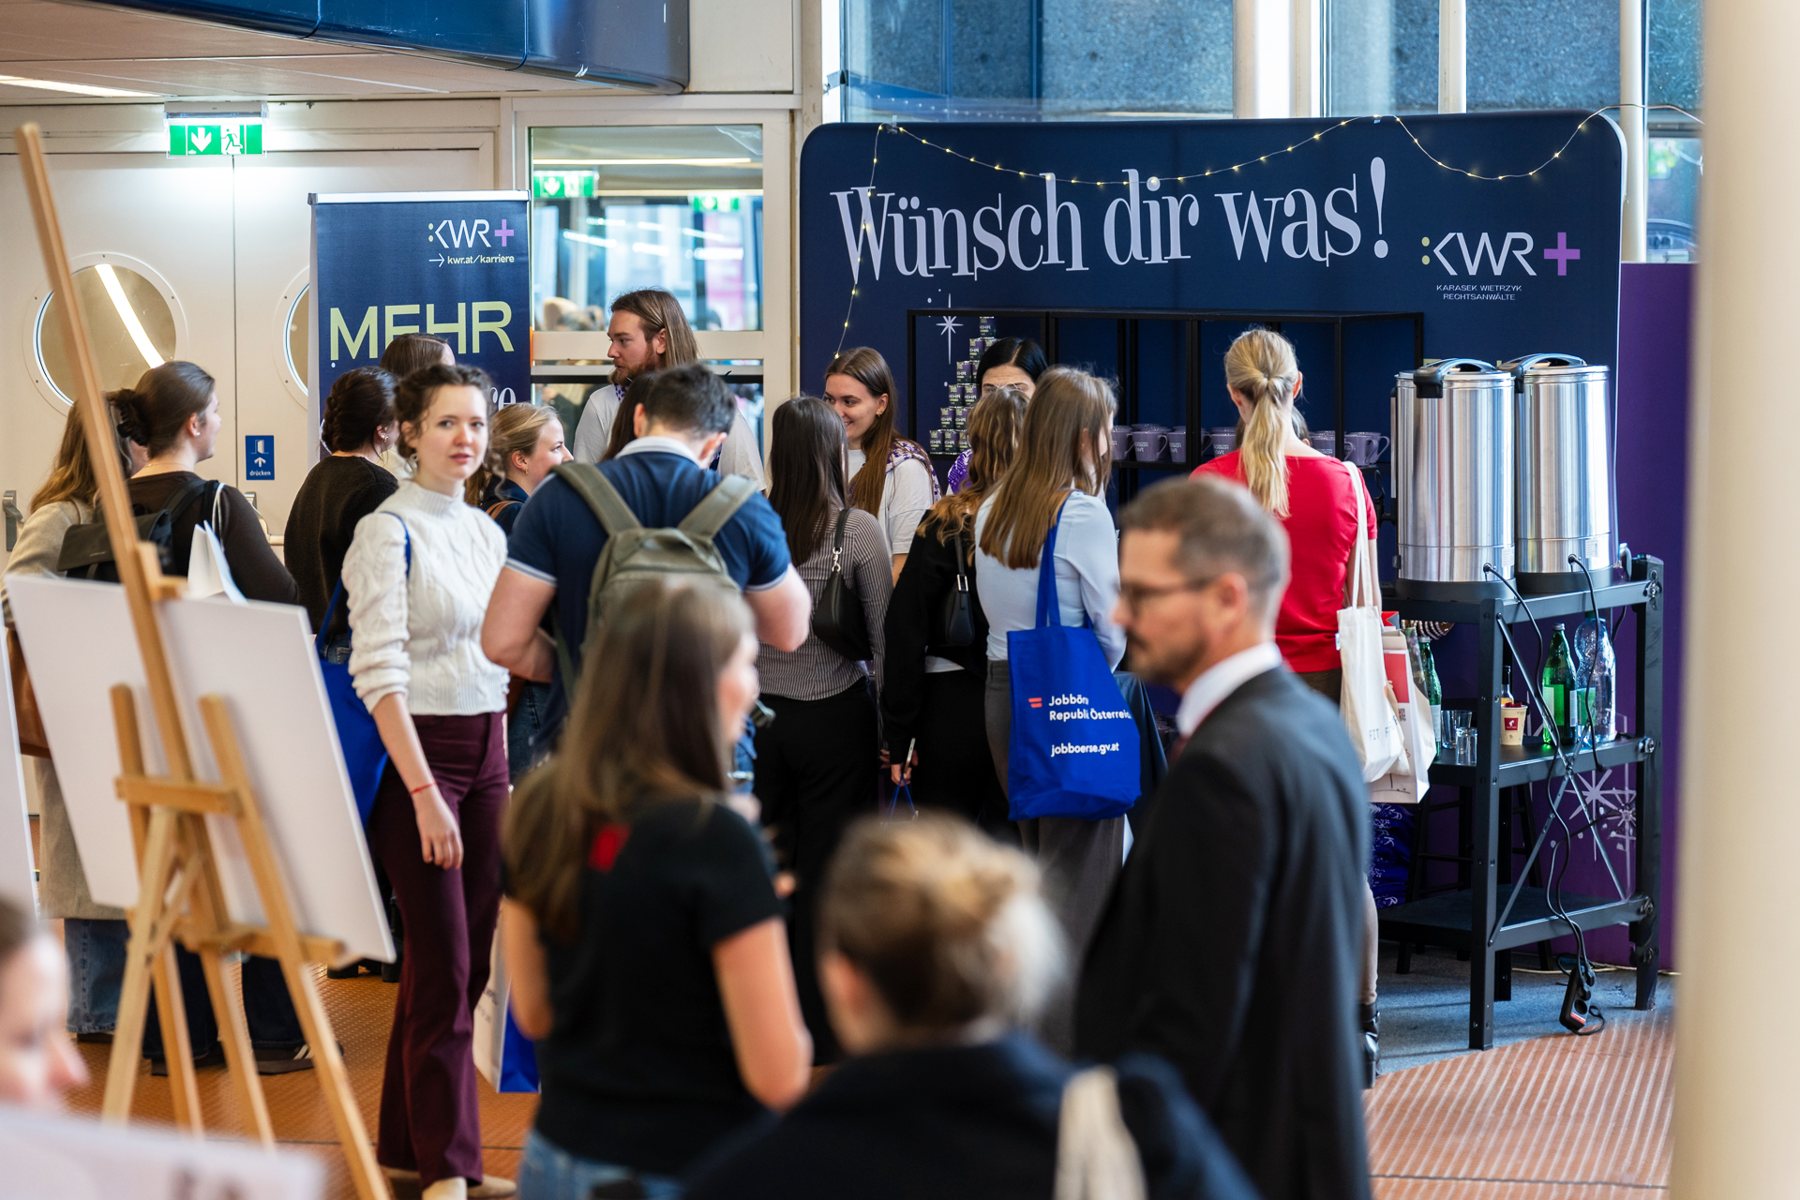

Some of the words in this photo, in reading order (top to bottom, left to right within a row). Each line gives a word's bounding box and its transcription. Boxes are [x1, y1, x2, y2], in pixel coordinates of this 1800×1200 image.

[830, 172, 1089, 284] Wünsch
[1102, 168, 1200, 265] dir
[1214, 156, 1389, 267] was!
[447, 253, 515, 265] kwr.at/karriere
[1443, 293, 1516, 301] RECHTSANWÄLTE
[330, 301, 515, 361] MEHR
[1050, 742, 1120, 757] jobboerse.gv.at
